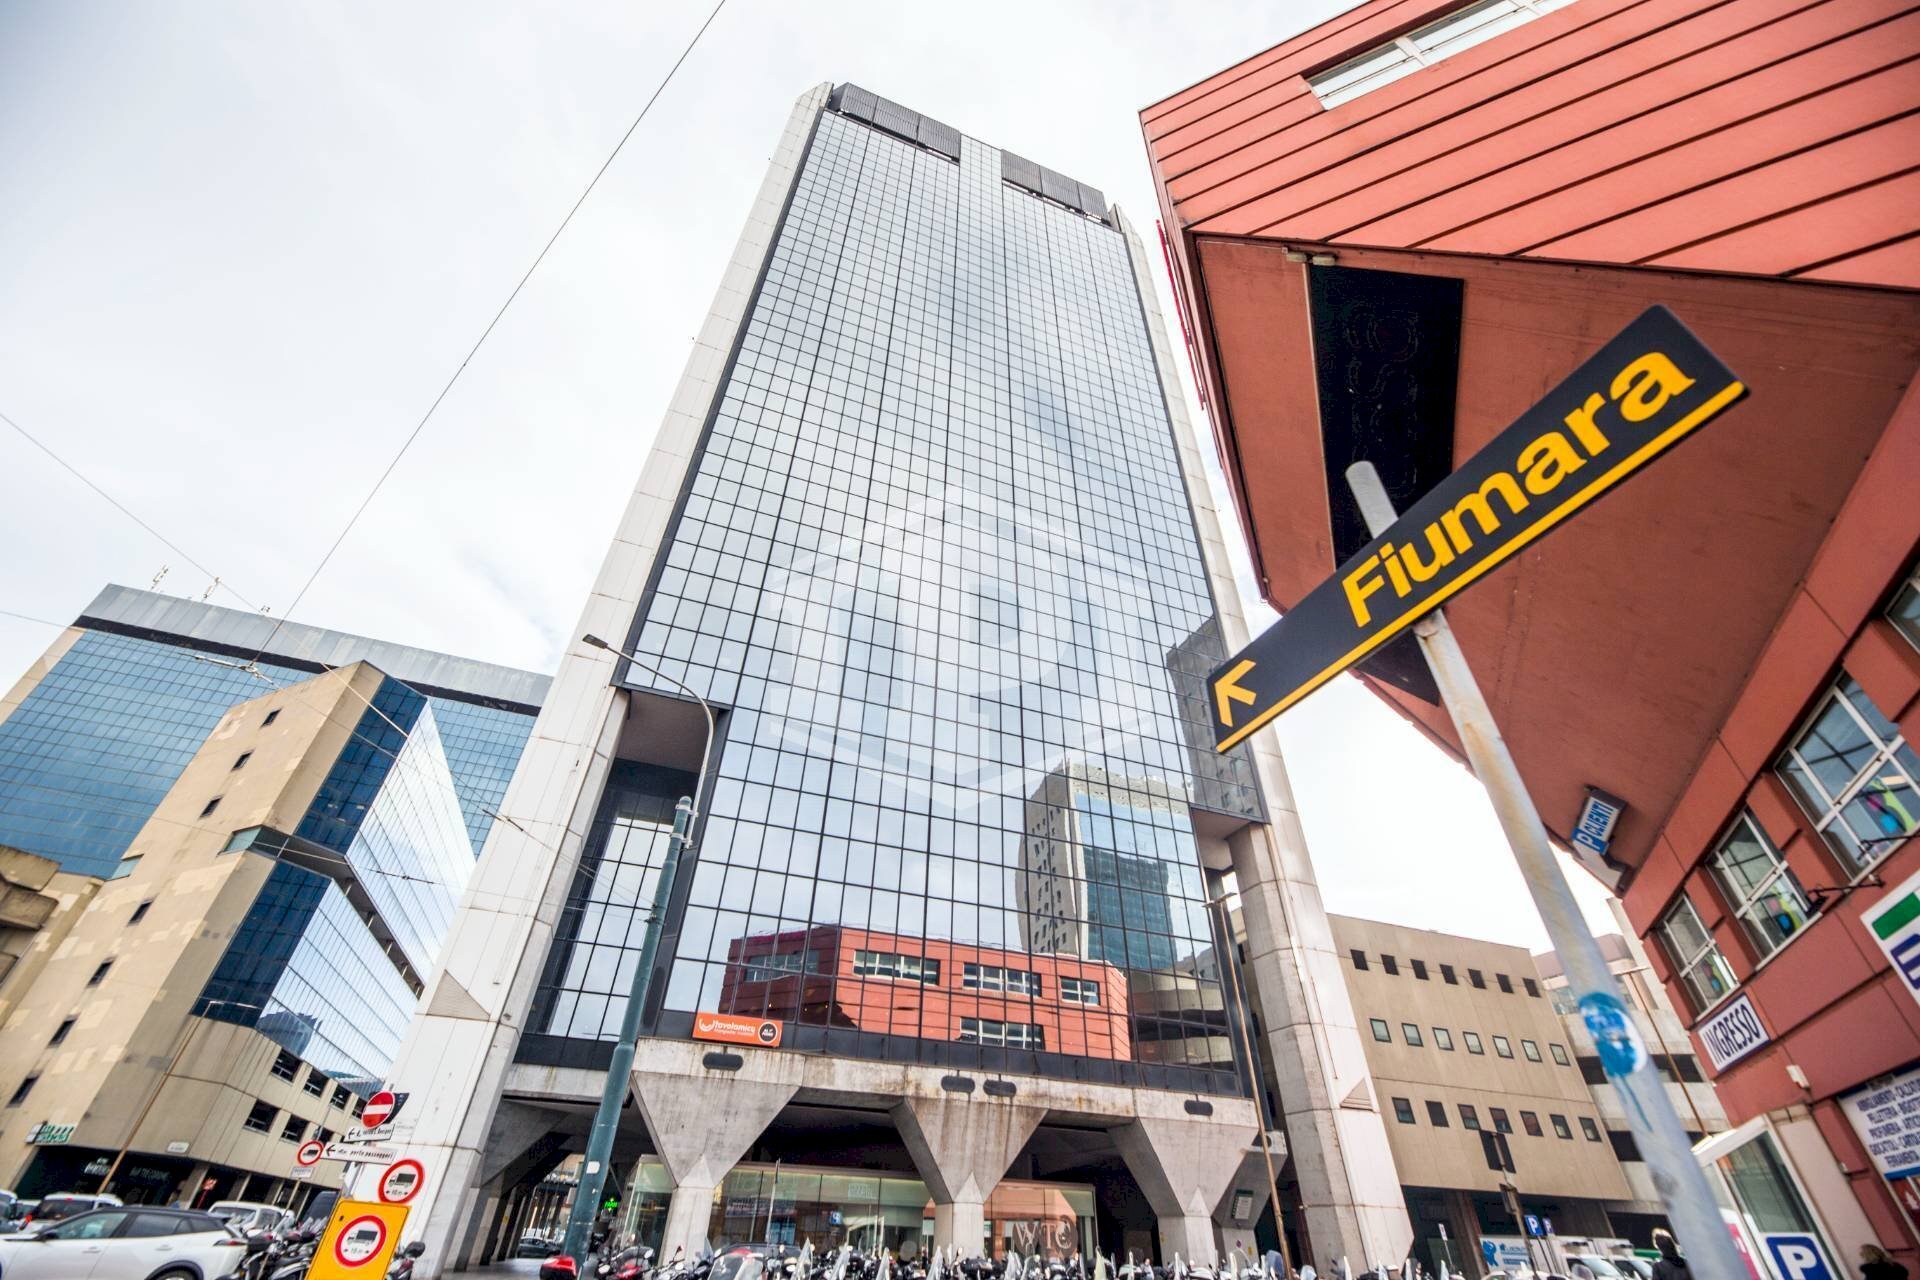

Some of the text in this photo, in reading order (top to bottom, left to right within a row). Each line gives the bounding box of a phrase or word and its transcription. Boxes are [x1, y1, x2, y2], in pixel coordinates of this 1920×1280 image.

[1342, 351, 1696, 628] Fiumara
[1584, 801, 1614, 836] CLIENTI
[1702, 1003, 1760, 1065] INGRESSO
[1777, 1245, 1817, 1280] P
